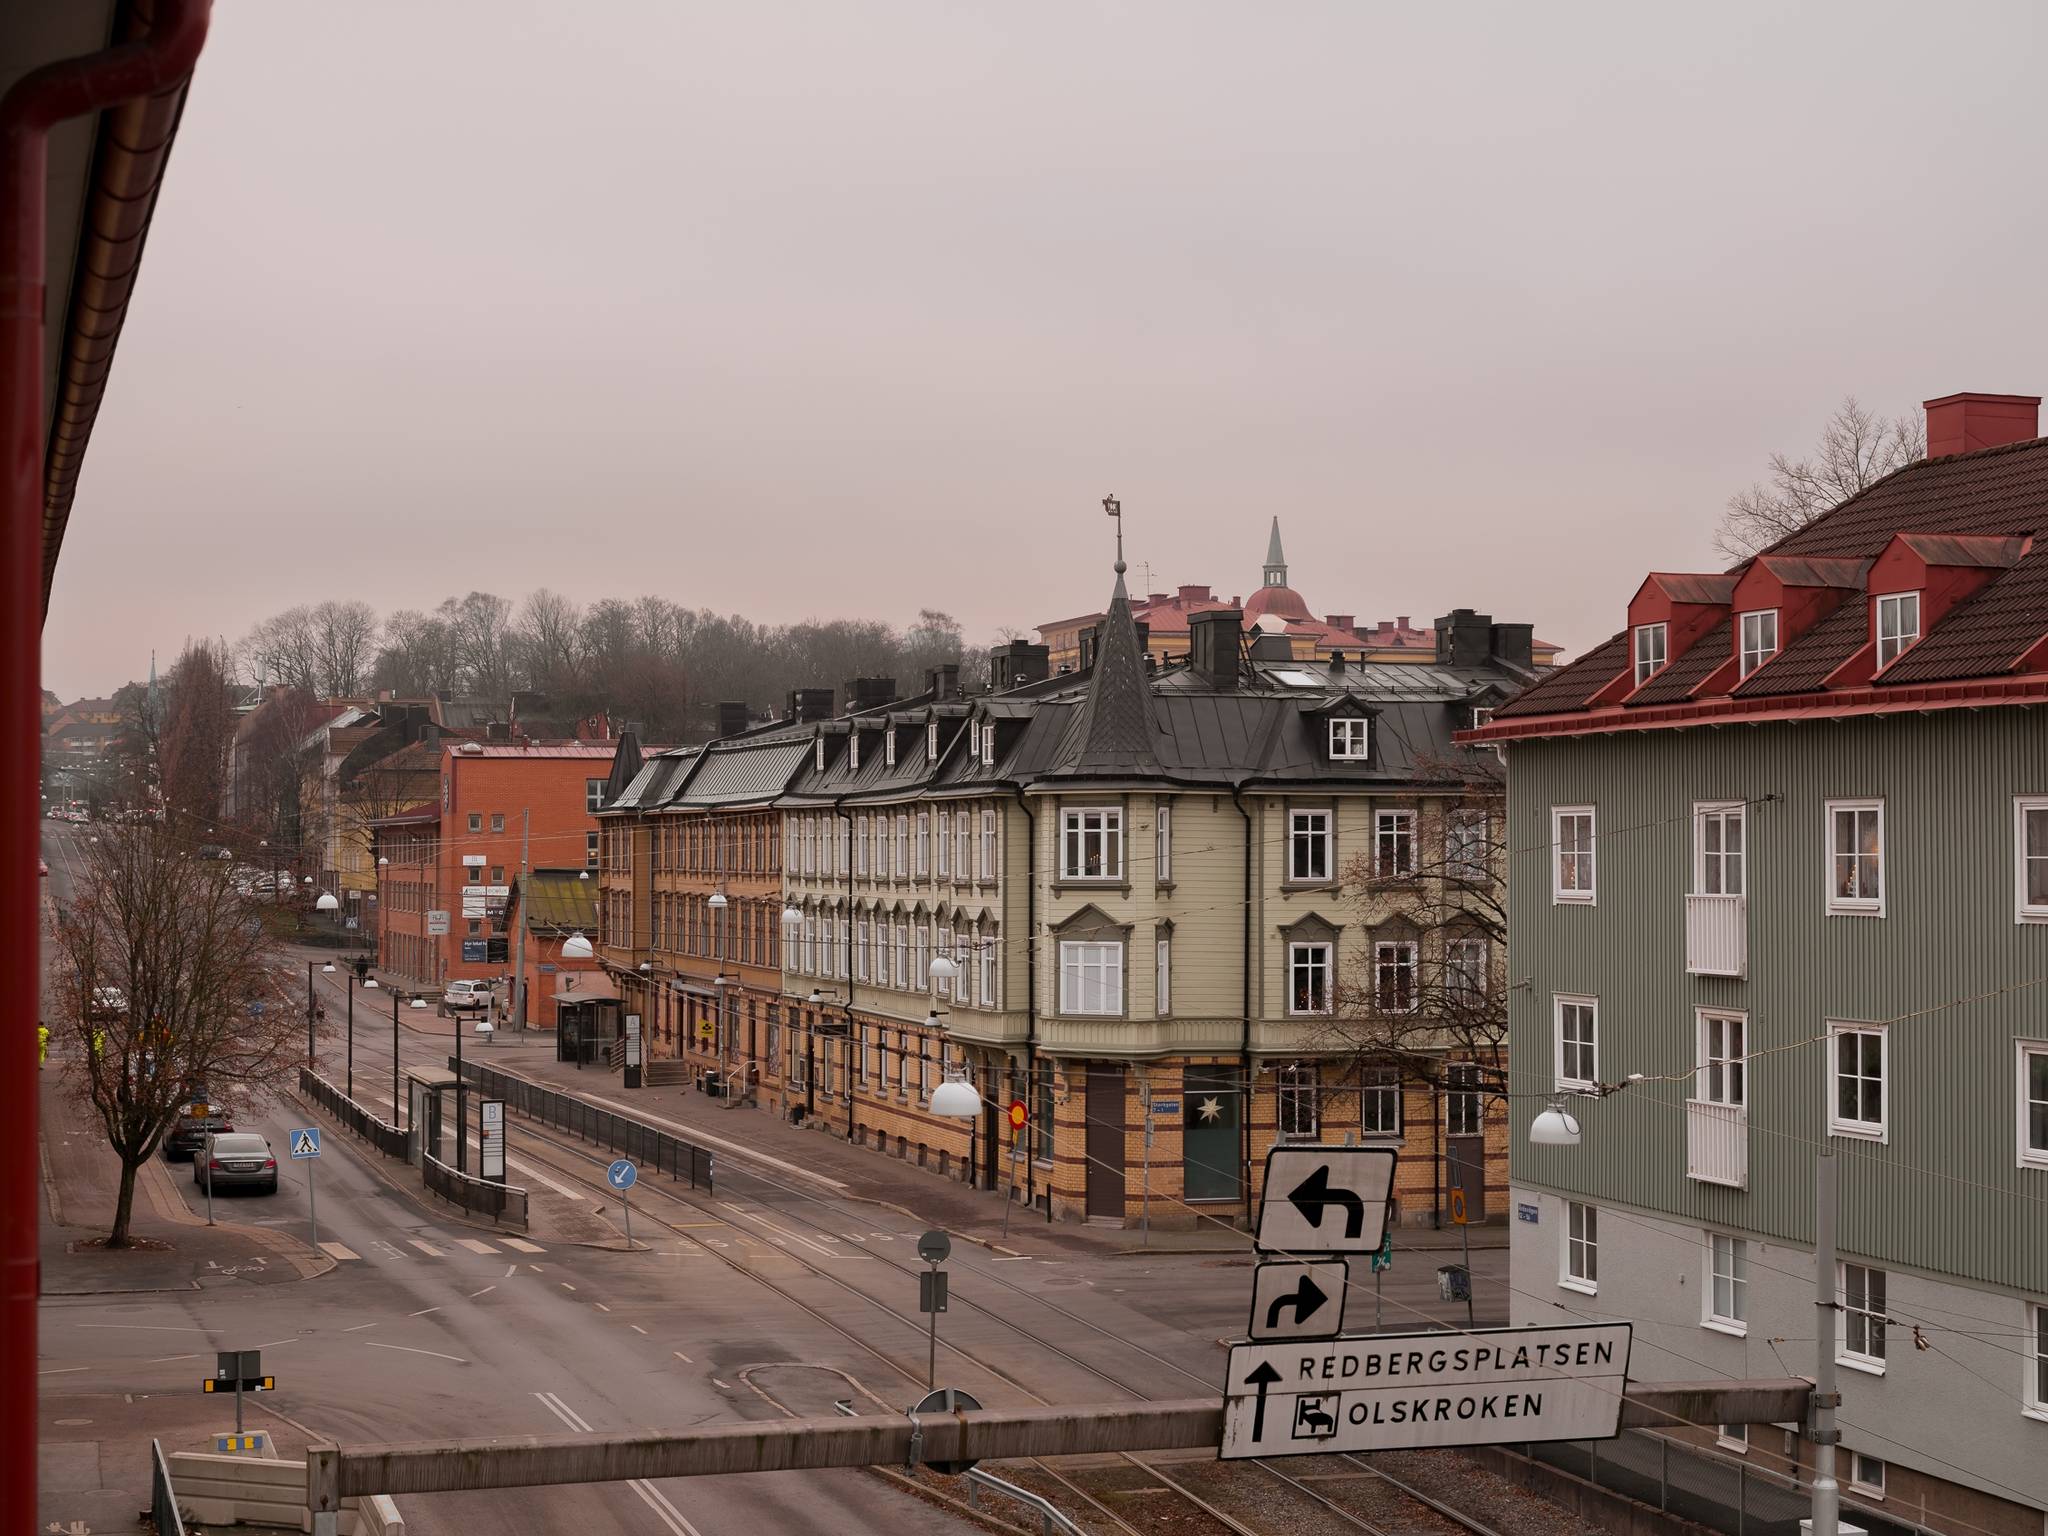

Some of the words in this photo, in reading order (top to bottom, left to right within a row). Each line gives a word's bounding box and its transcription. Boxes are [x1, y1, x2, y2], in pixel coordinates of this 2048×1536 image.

[488, 1105, 497, 1119] B
[1300, 1341, 1613, 1380] REDBERGSPLATSEN
[1349, 1394, 1543, 1426] OLSKROKEN
